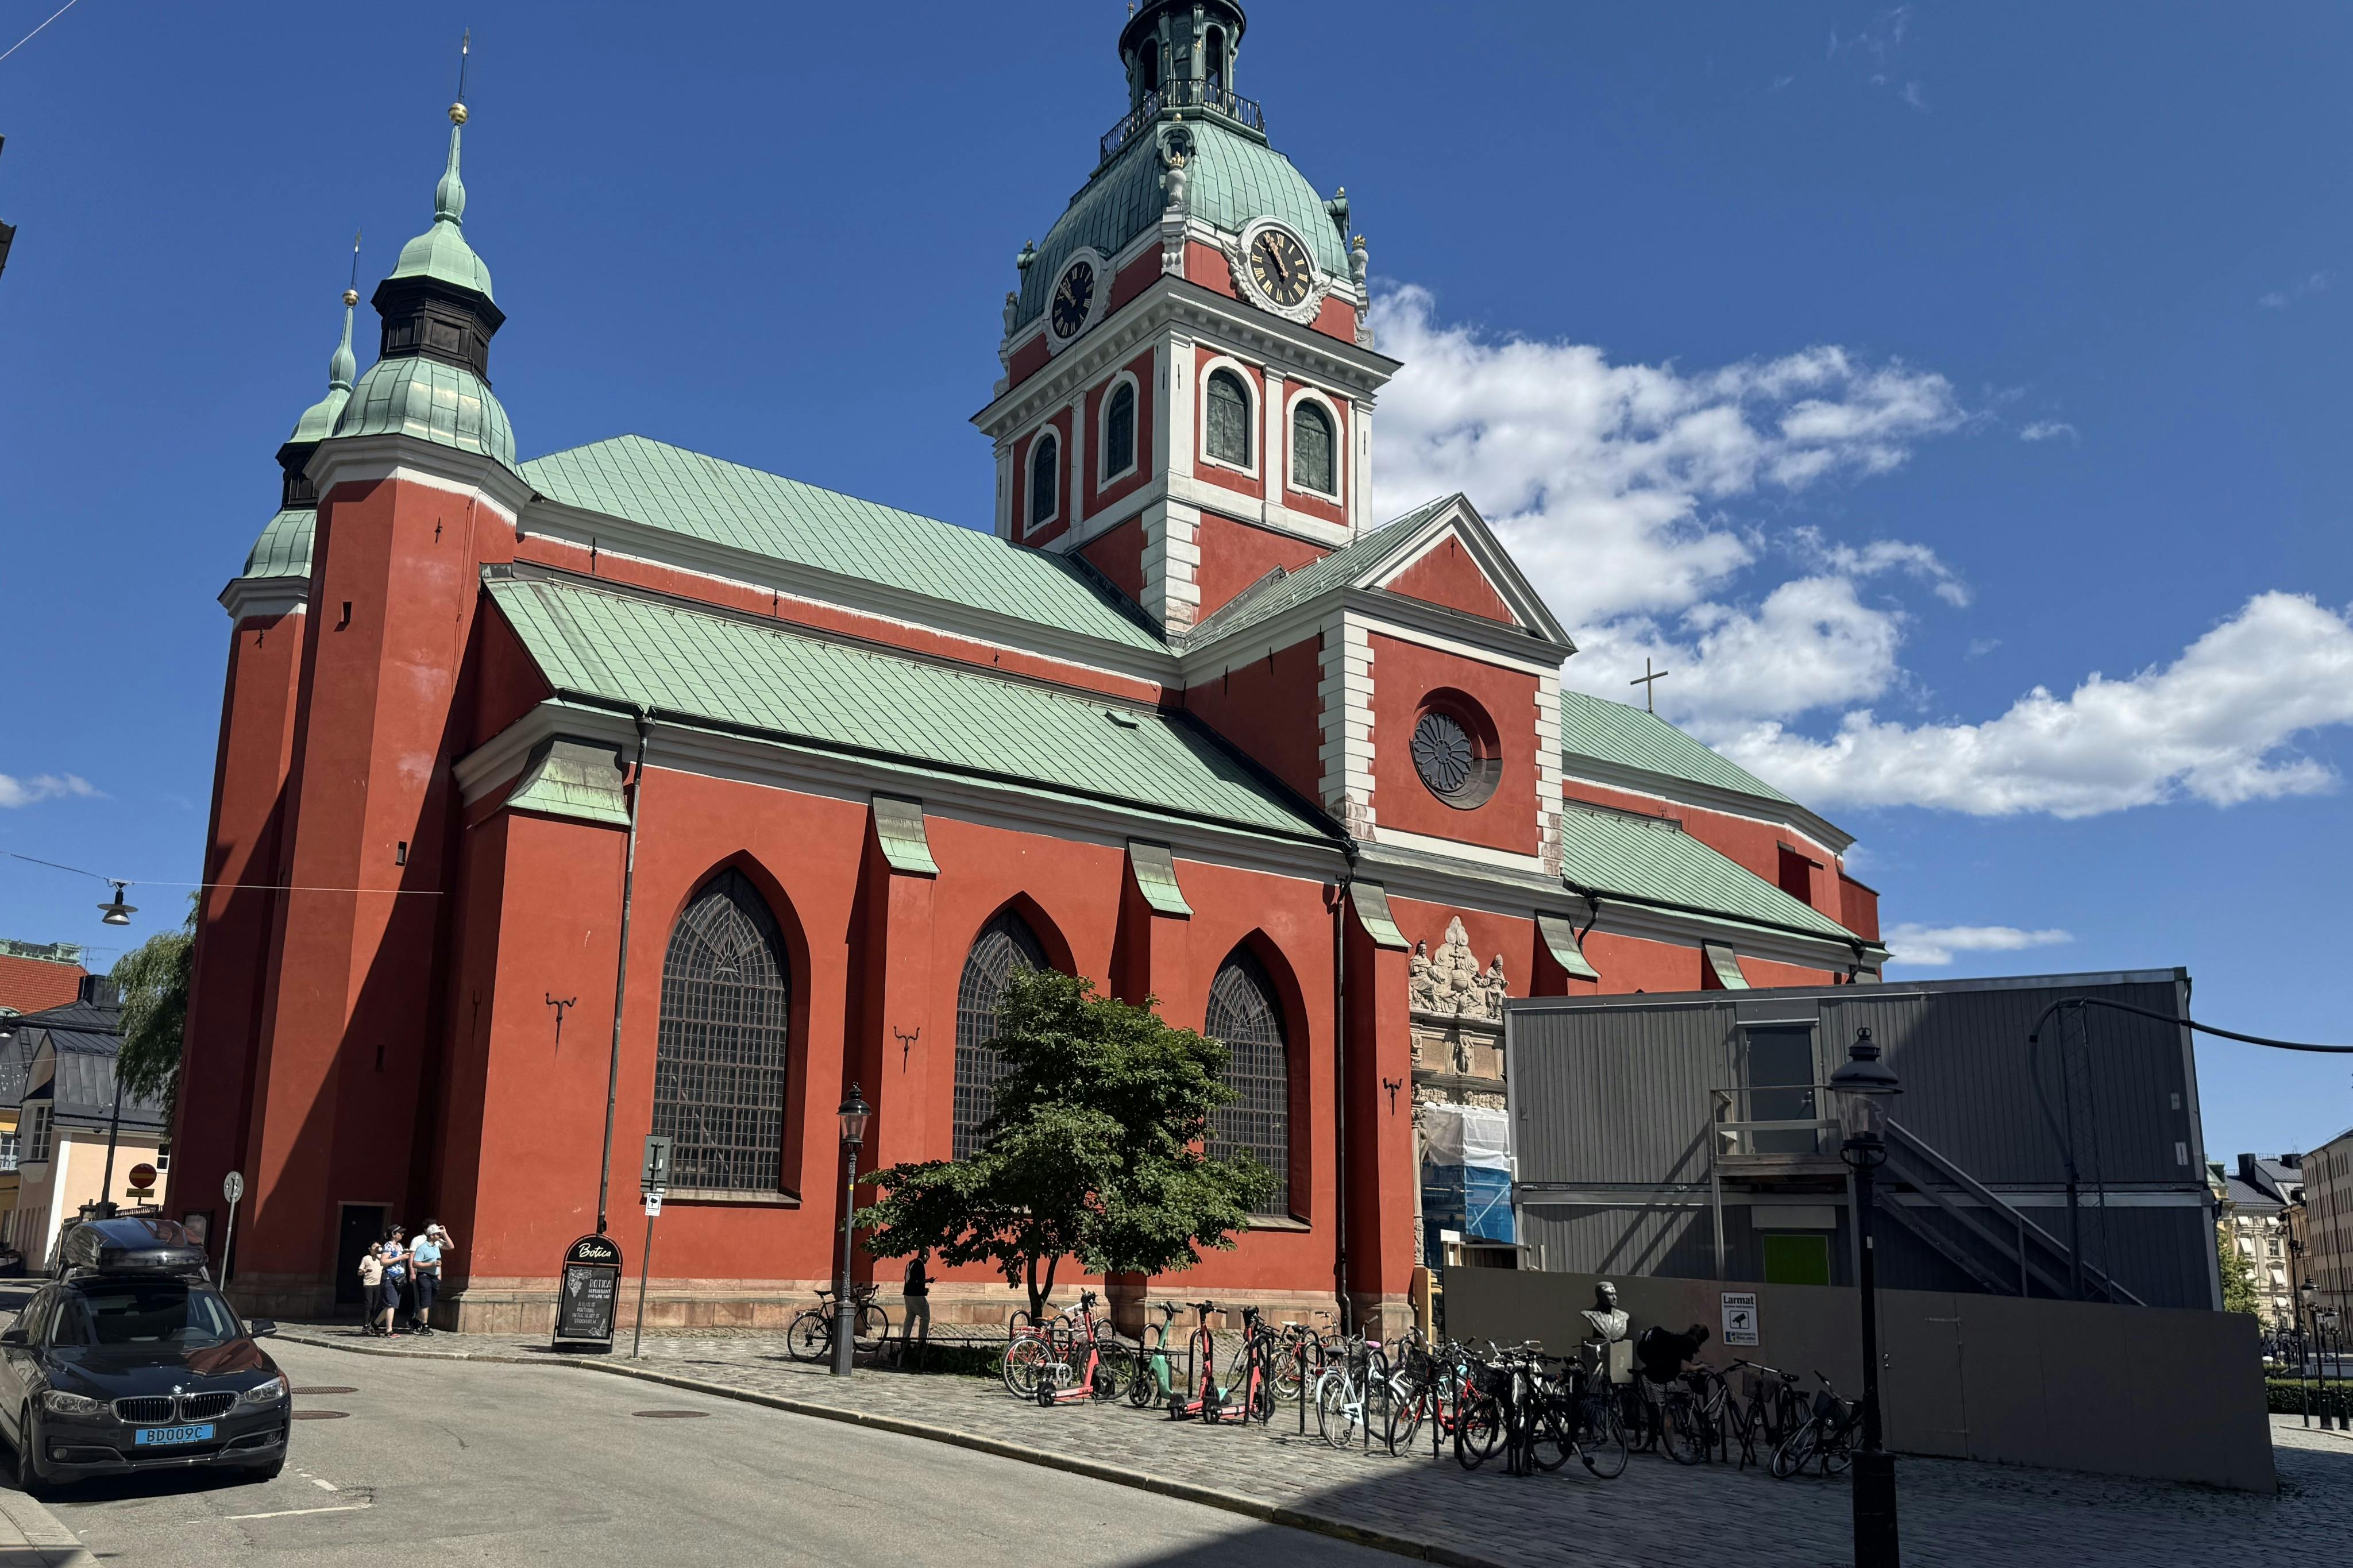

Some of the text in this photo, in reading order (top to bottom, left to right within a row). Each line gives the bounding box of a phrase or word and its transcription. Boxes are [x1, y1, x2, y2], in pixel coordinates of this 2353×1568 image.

[578, 1243, 612, 1258] Botica
[589, 1279, 611, 1288] BOTICA
[1723, 1295, 1754, 1305] Larmat
[147, 1427, 203, 1442] BD009C
